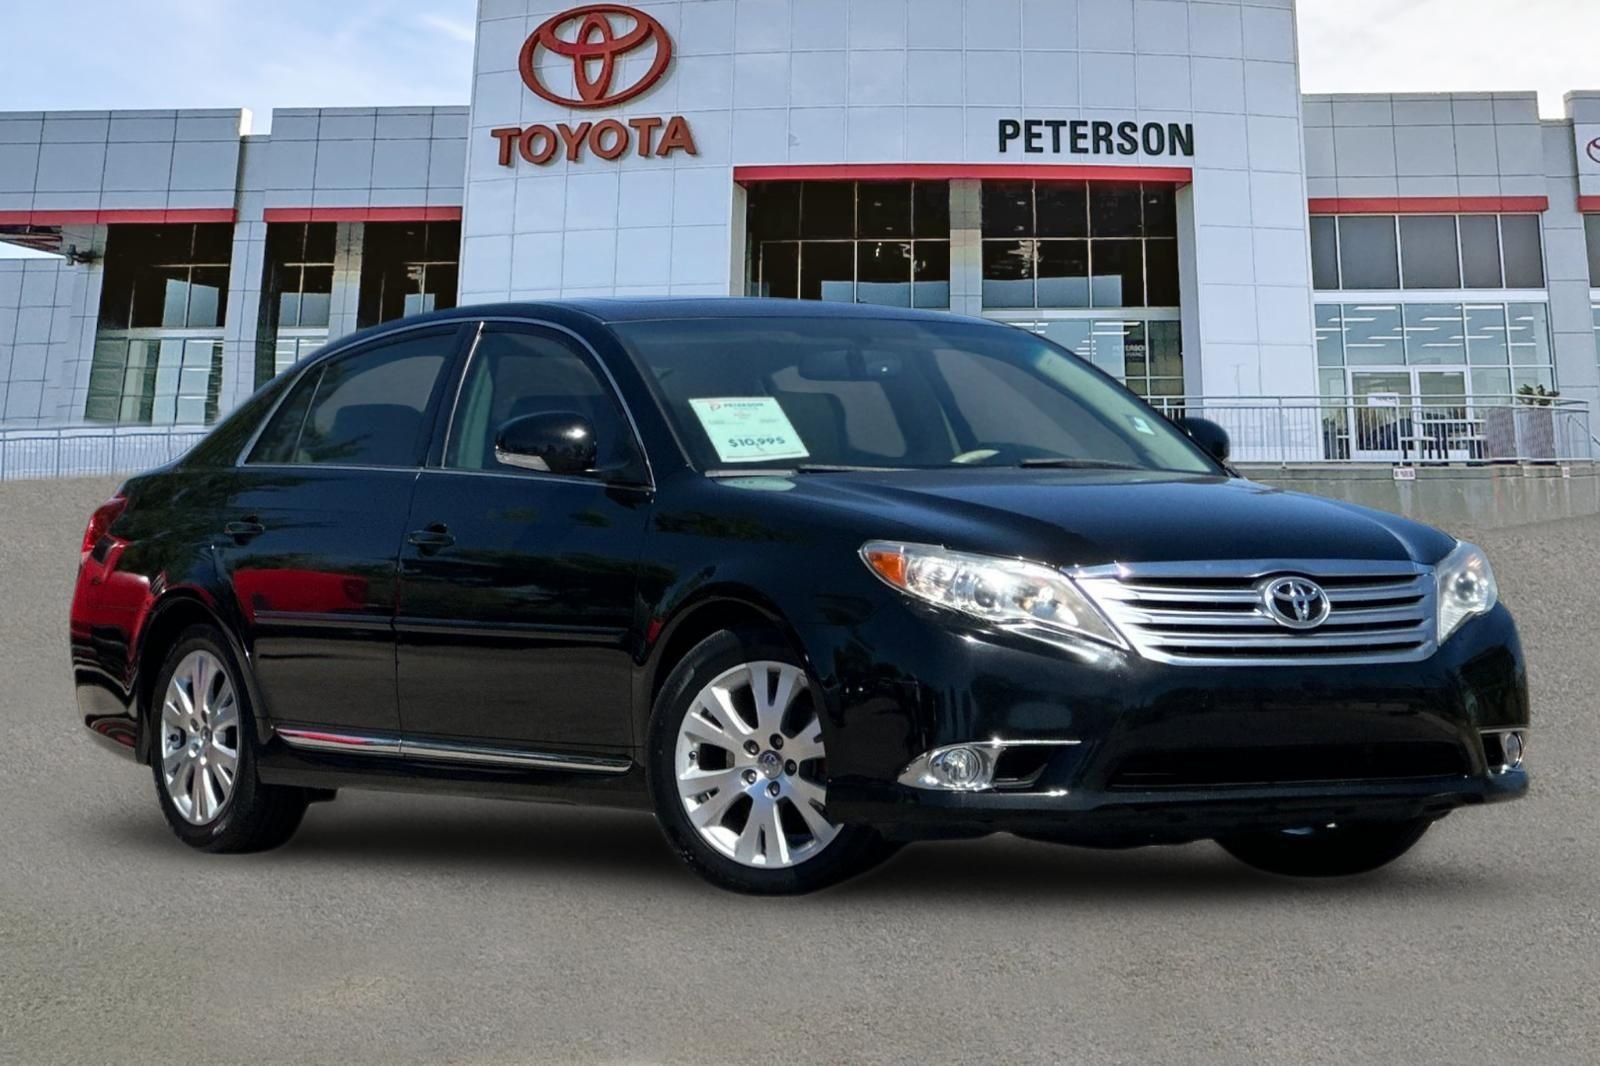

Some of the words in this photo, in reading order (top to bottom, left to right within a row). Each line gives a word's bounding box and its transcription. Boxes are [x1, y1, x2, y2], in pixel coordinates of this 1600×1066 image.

[491, 116, 697, 166] TOYOTA
[998, 119, 1194, 156] PETERSON
[728, 436, 785, 448] $10,995
